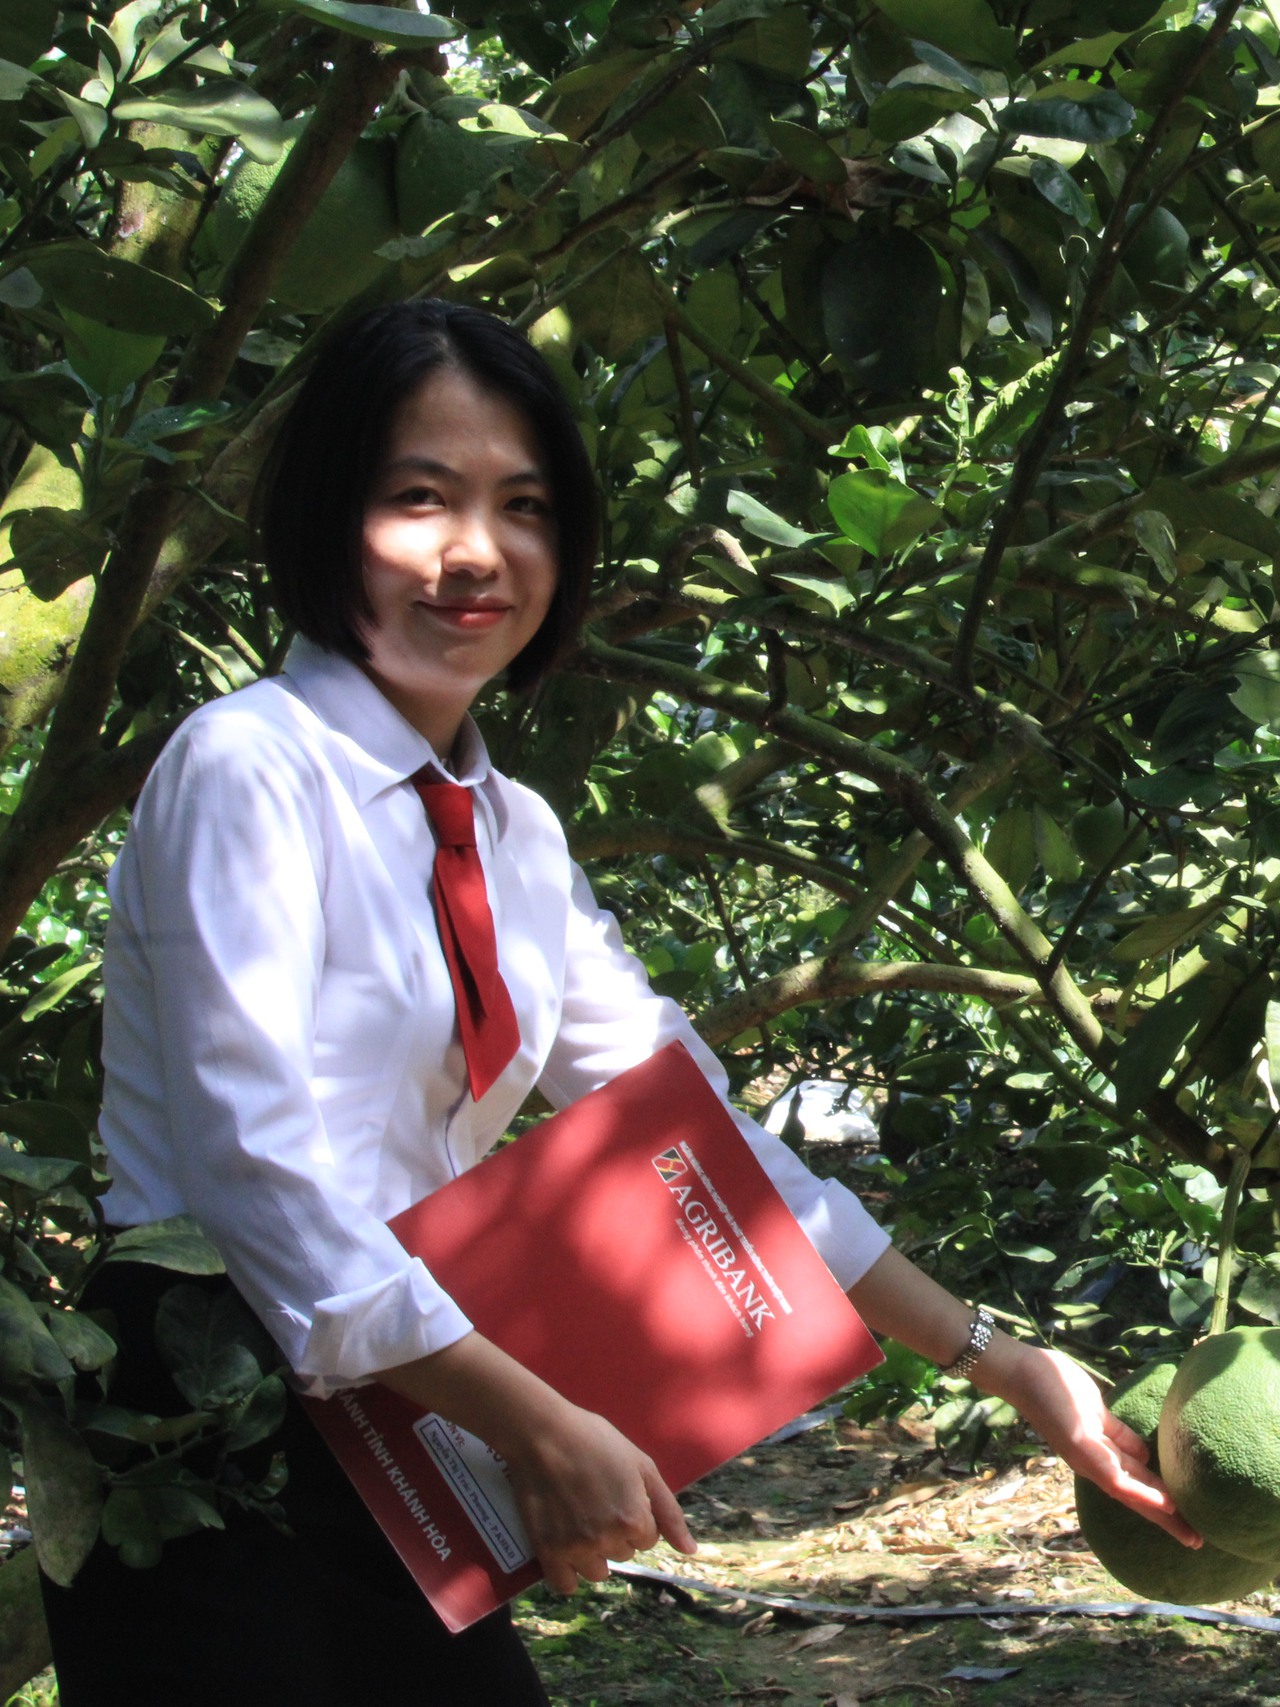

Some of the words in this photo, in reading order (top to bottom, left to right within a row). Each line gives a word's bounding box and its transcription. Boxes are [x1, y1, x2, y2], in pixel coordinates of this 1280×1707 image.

[669, 1186, 775, 1331] AGRIBANK
[387, 1466, 430, 1524] KHÁNH
[422, 1523, 452, 1562] HÒA
